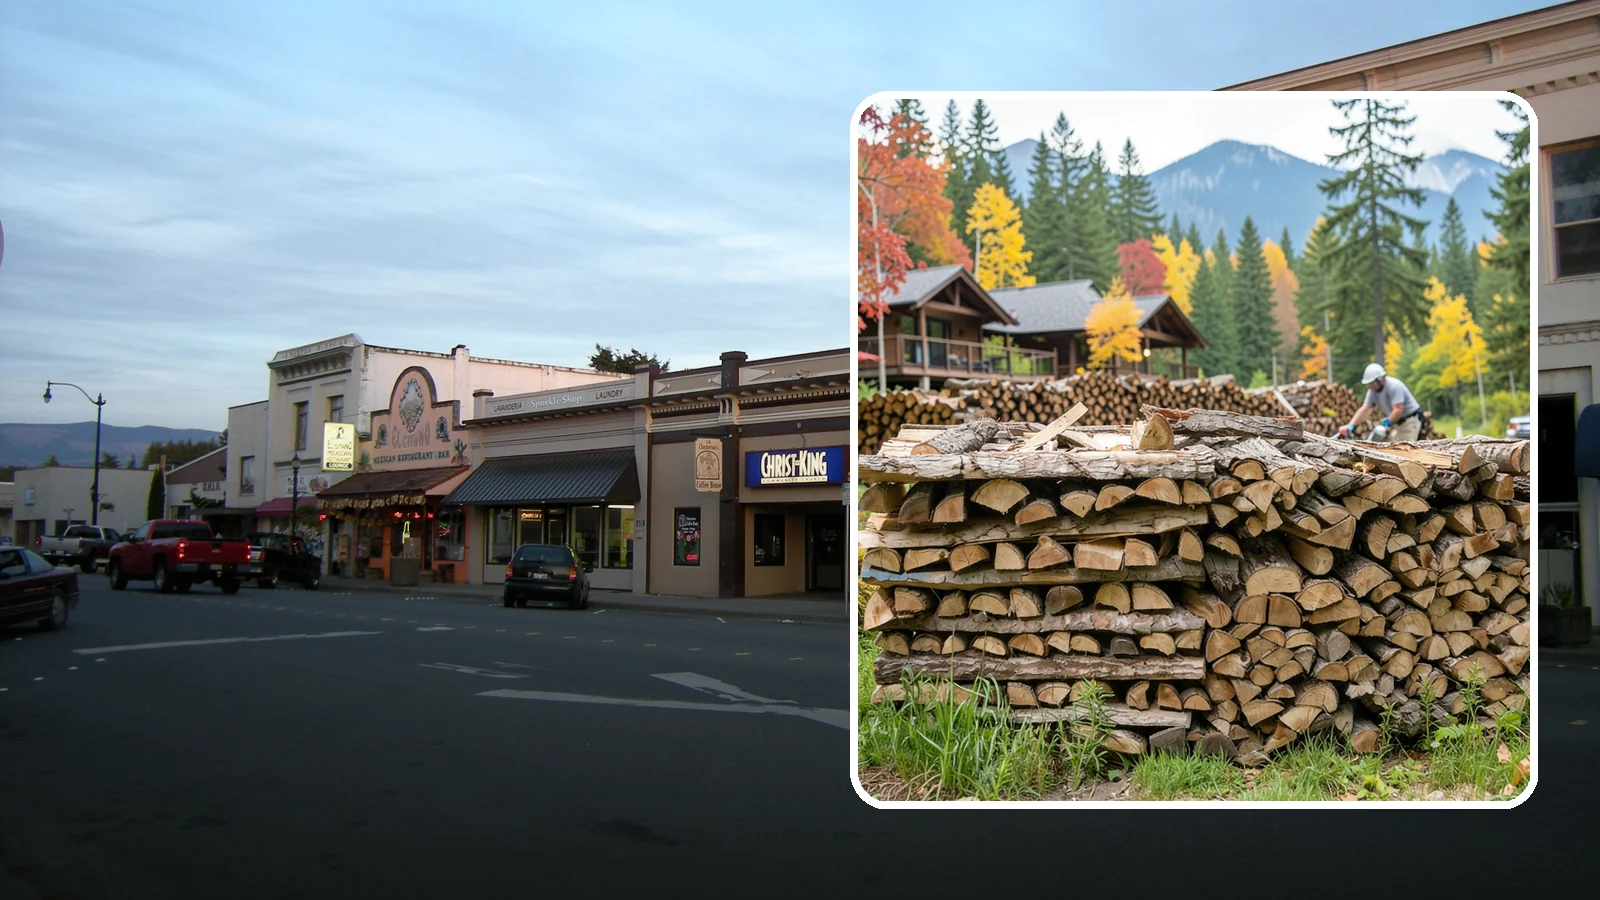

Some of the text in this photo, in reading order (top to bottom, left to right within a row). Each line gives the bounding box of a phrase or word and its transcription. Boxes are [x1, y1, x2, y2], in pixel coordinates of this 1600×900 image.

[561, 394, 582, 406] Shop
[596, 389, 623, 400] LAUNDRY
[494, 402, 522, 412] LAVANDERIA
[373, 454, 396, 464] MEXICAN
[398, 451, 434, 462] RESTAURANT
[438, 450, 450, 459] BAR
[710, 481, 722, 489] House
